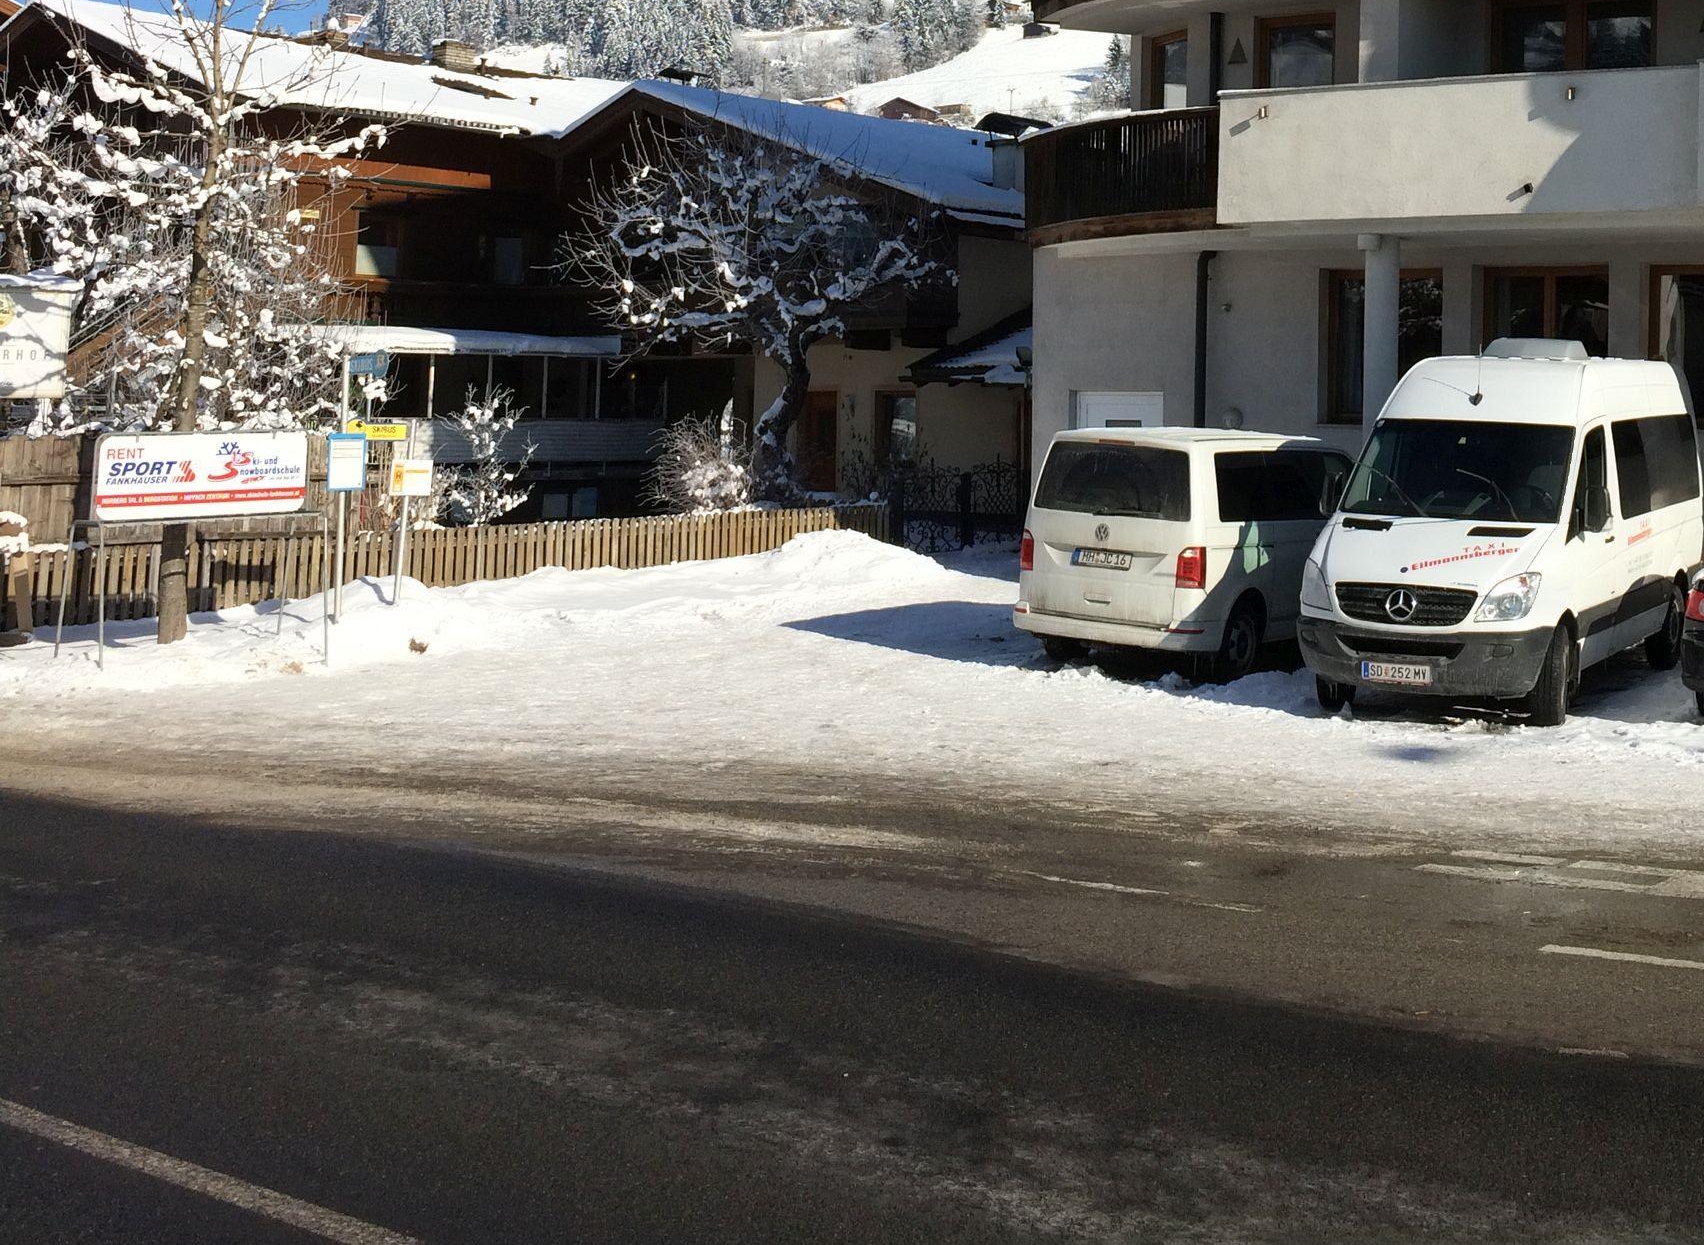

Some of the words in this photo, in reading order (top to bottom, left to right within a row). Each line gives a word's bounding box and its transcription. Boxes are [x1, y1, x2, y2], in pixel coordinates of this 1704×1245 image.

[107, 448, 145, 460] RENT
[264, 456, 278, 464] und
[109, 461, 178, 476] SPORT
[105, 477, 168, 486] FANKHAUSER
[1463, 542, 1505, 553] TAXI
[1370, 664, 1383, 677] SD
[1391, 666, 1411, 679] 252
